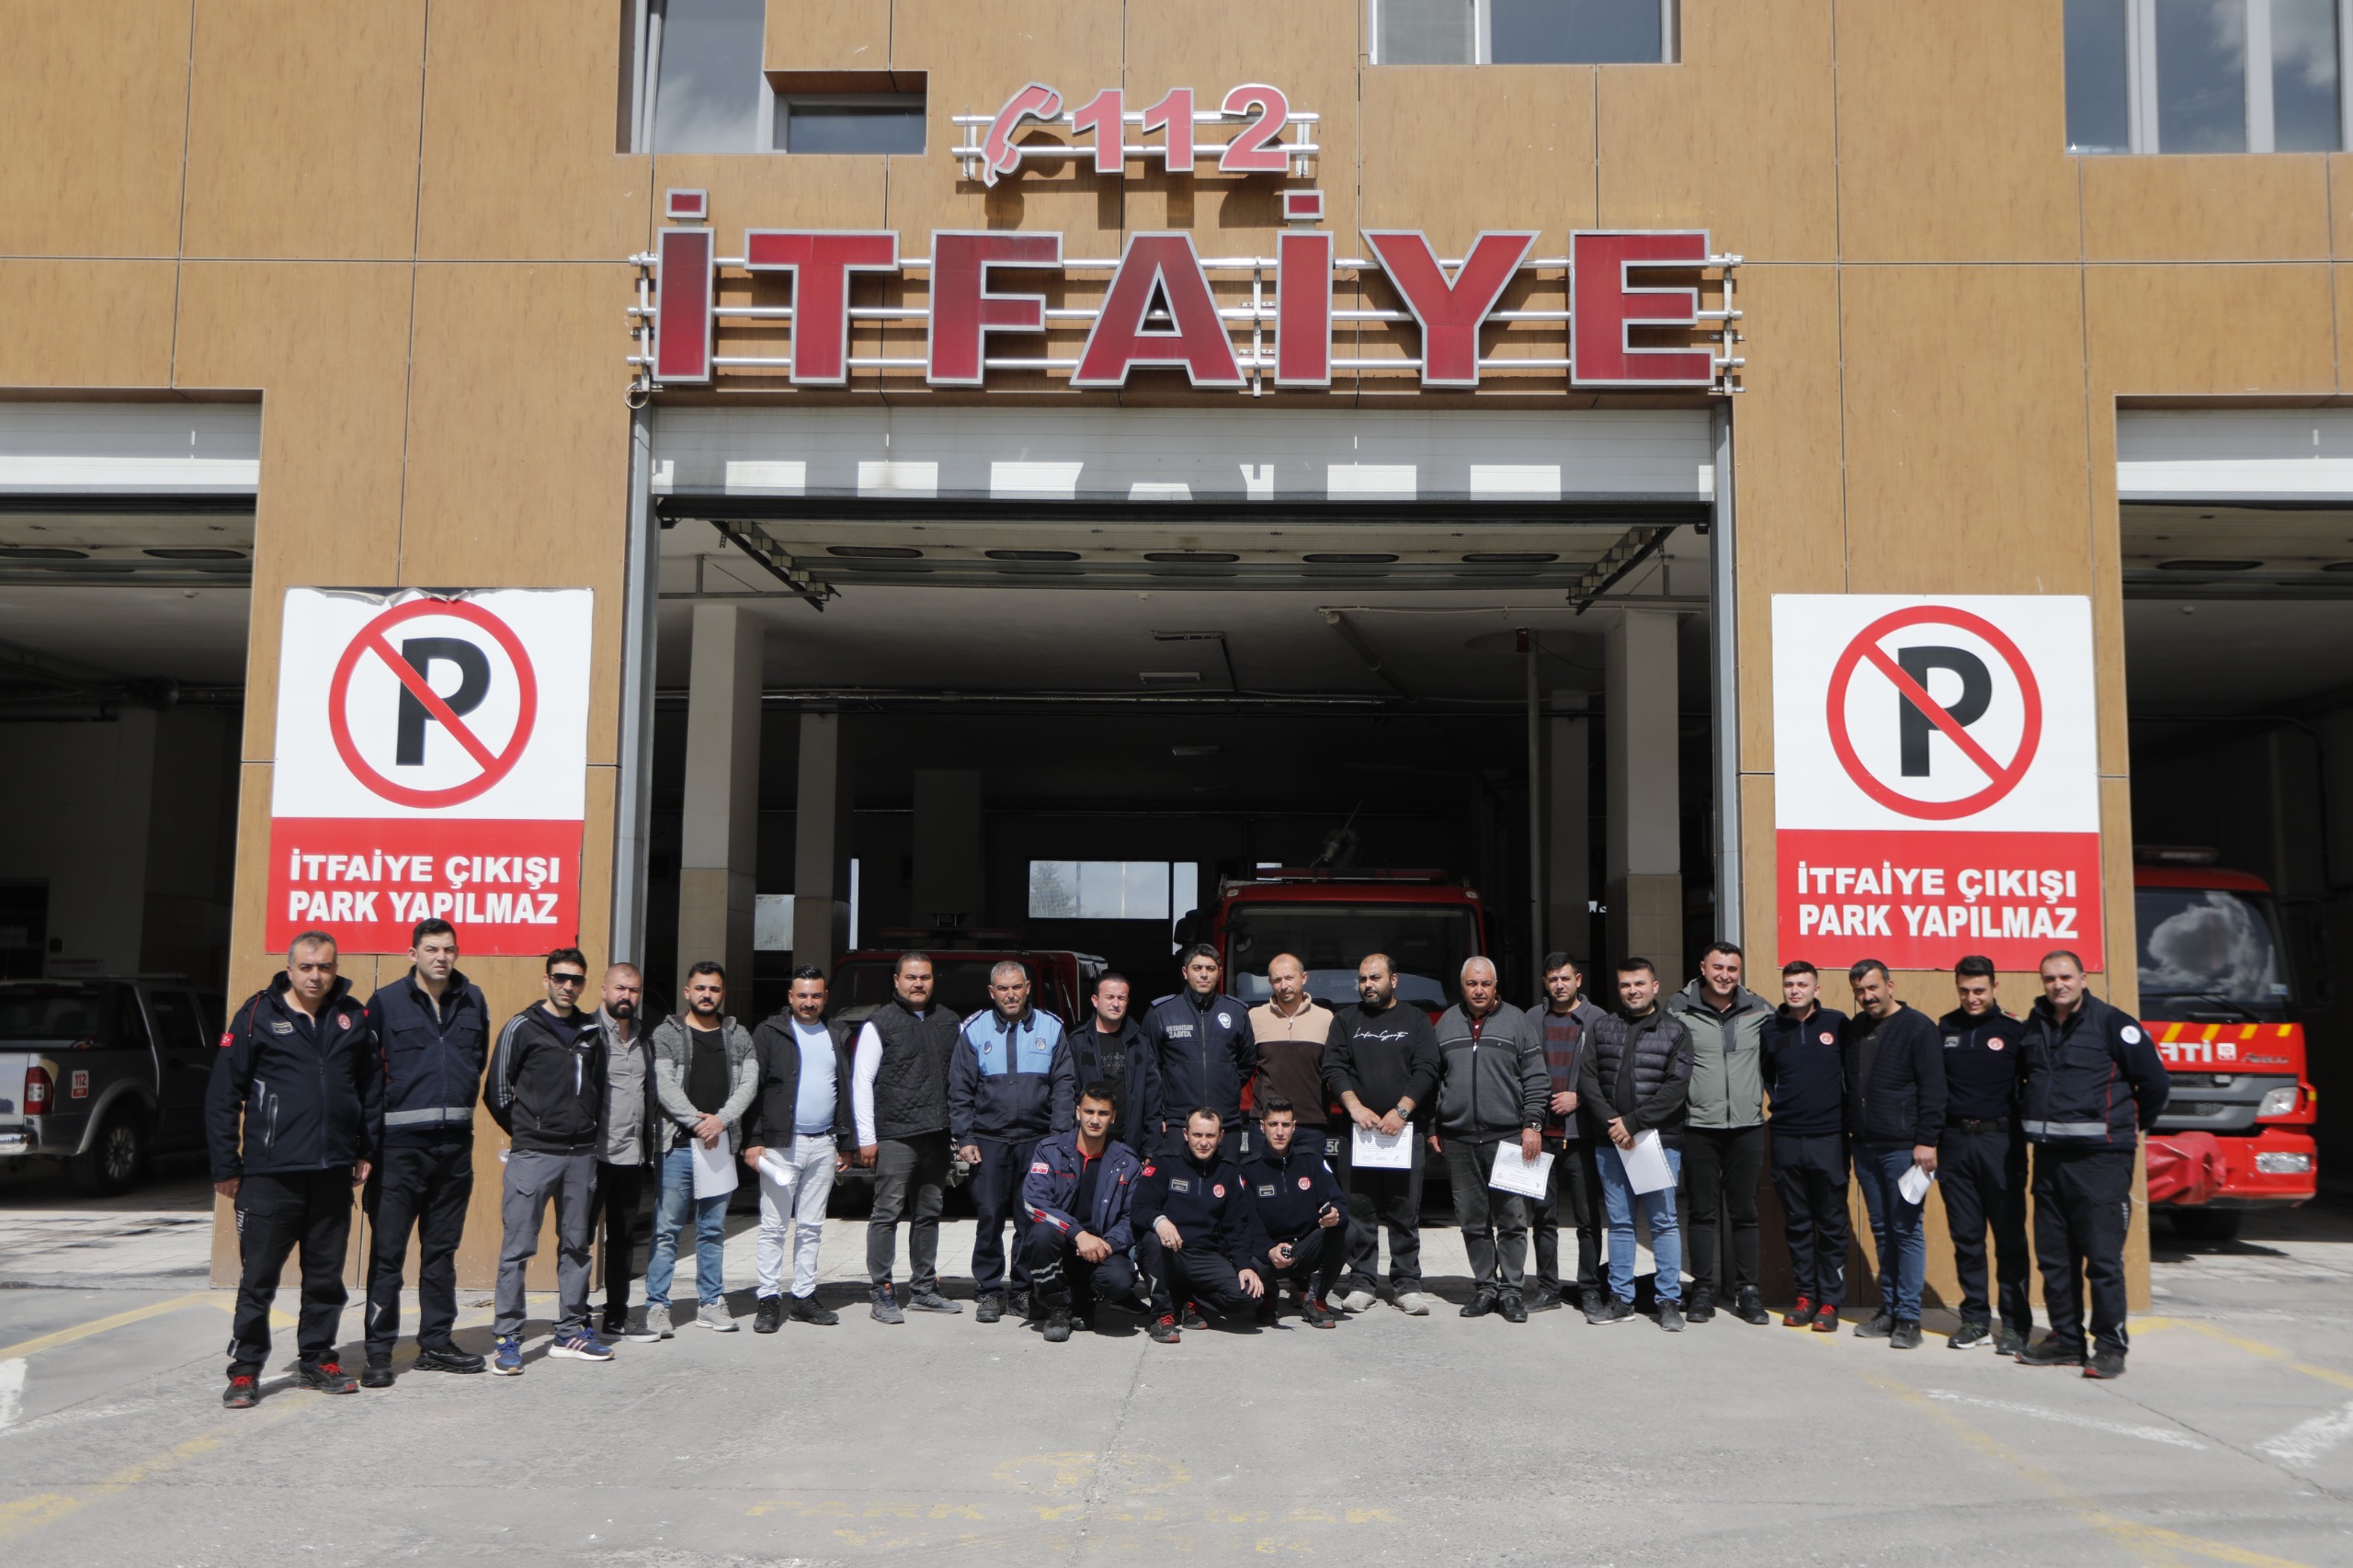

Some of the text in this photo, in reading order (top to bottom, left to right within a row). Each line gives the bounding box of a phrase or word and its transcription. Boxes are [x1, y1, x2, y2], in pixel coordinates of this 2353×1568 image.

[1071, 82, 1290, 173] 112
[654, 187, 1717, 390] İTFAİYE
[290, 848, 560, 890] İTFAİYE ÇIKIŞI
[1797, 860, 2076, 904] İTFAİYE ÇIKIŞI
[289, 890, 559, 924] PARK YAPILMAZ
[1799, 903, 2079, 939] PARK YAPILMAZ
[1168, 1030, 1192, 1040] ZABITA
[74, 1074, 87, 1086] 112
